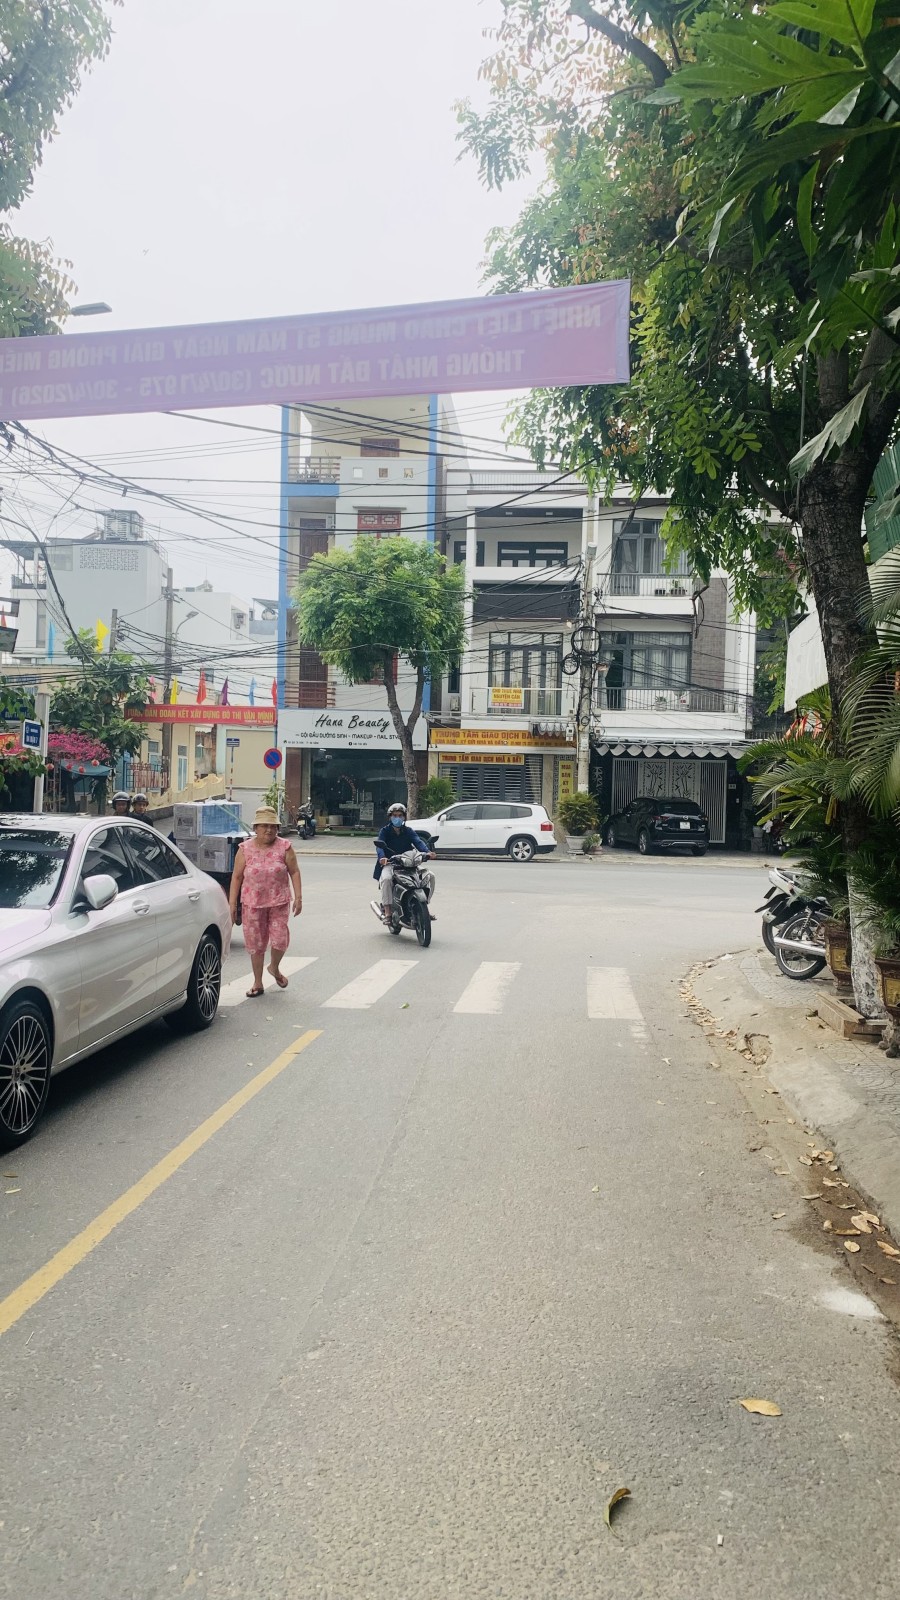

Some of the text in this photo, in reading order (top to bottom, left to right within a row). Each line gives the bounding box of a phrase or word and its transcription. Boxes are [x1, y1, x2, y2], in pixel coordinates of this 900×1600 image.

[178, 708, 189, 718] KẾT
[191, 709, 202, 719] XÂY
[203, 710, 221, 720] DỰNG
[315, 714, 391, 733] Hana Beauty
[463, 730, 478, 738] TÂM
[481, 731, 499, 739] GIAO
[501, 731, 519, 739] DỊCH
